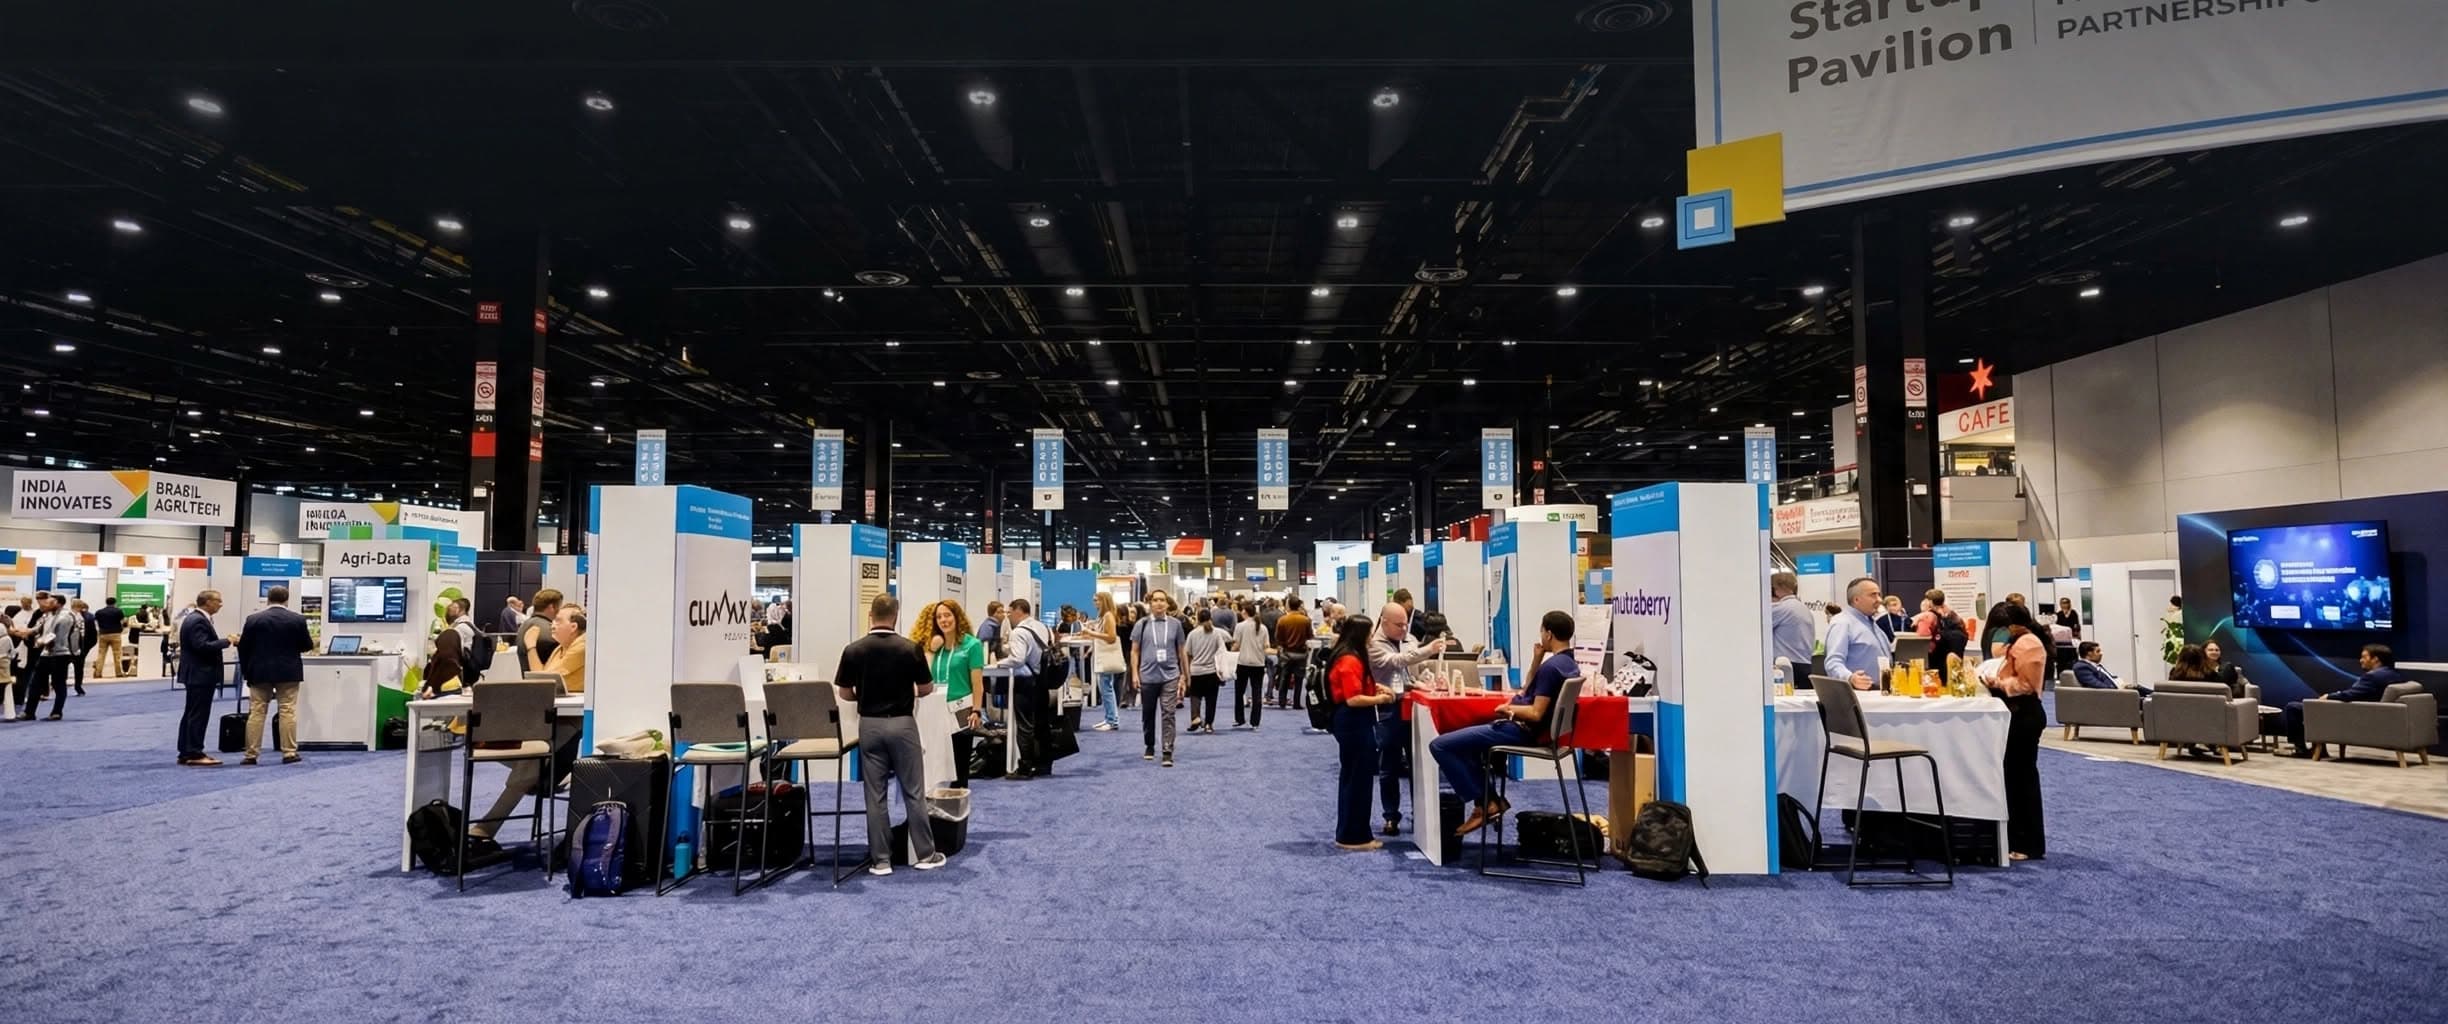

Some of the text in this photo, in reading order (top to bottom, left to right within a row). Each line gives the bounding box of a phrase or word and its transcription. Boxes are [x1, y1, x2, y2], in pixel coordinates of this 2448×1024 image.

[1789, 0, 1982, 40] Star
[2057, 0, 2322, 39] PARTNERSH
[1788, 23, 2013, 94] Pavilion
[1958, 402, 2010, 433] CAFE
[20, 495, 113, 510] INNOVATES
[21, 479, 67, 494] INDIA
[340, 551, 411, 569] Agri-Data
[689, 591, 748, 627] CLIMAX
